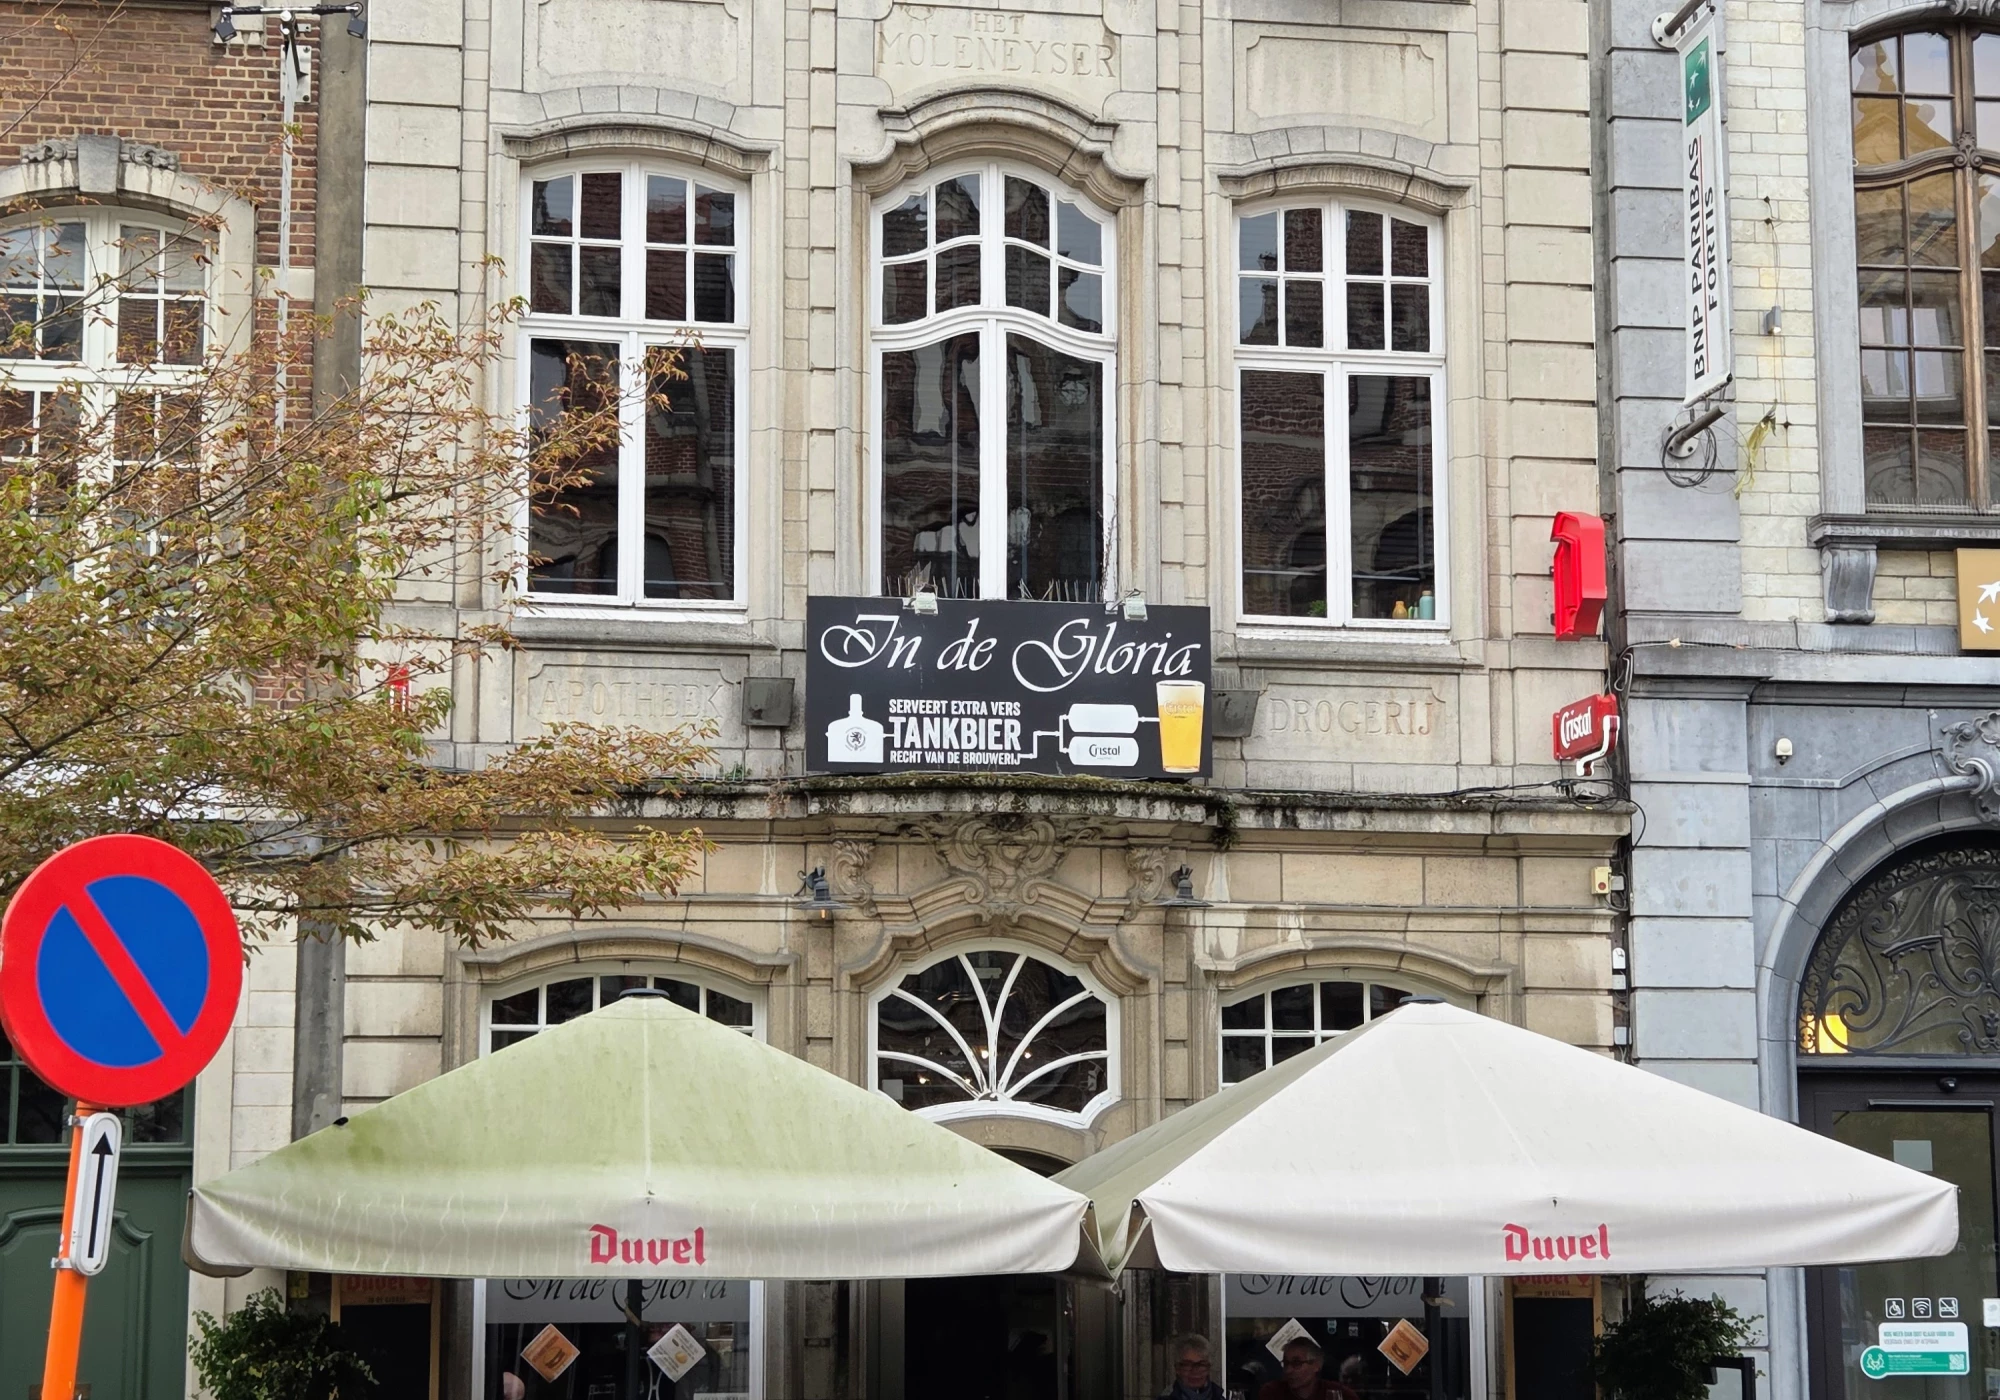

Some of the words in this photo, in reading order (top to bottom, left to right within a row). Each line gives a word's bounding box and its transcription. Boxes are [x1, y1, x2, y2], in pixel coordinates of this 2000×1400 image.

[974, 12, 1025, 35] HET
[877, 31, 1116, 78] MOLENEYSER
[1689, 138, 1702, 294] PARIBAS
[1705, 186, 1717, 311] FORTIS
[1693, 304, 1705, 380] BNP
[820, 614, 922, 669] In
[937, 617, 997, 671] de
[1011, 617, 1201, 692] Gloria
[537, 680, 724, 719] APOTHEEK
[889, 698, 948, 716] SERVEERT
[951, 700, 988, 716] EXTRA
[991, 701, 1021, 717] VERS
[1269, 697, 1434, 736] DROGERIJ
[889, 716, 1021, 751] TANKBIER
[1560, 705, 1593, 749] Cristal
[890, 750, 922, 764] RECHT
[923, 751, 945, 764] VAN
[947, 751, 961, 765] DE
[963, 752, 1021, 766] BROUWERIJ
[1088, 743, 1121, 758] Cristal
[589, 1223, 707, 1266] Duvel
[1502, 1222, 1611, 1262] Duvel
